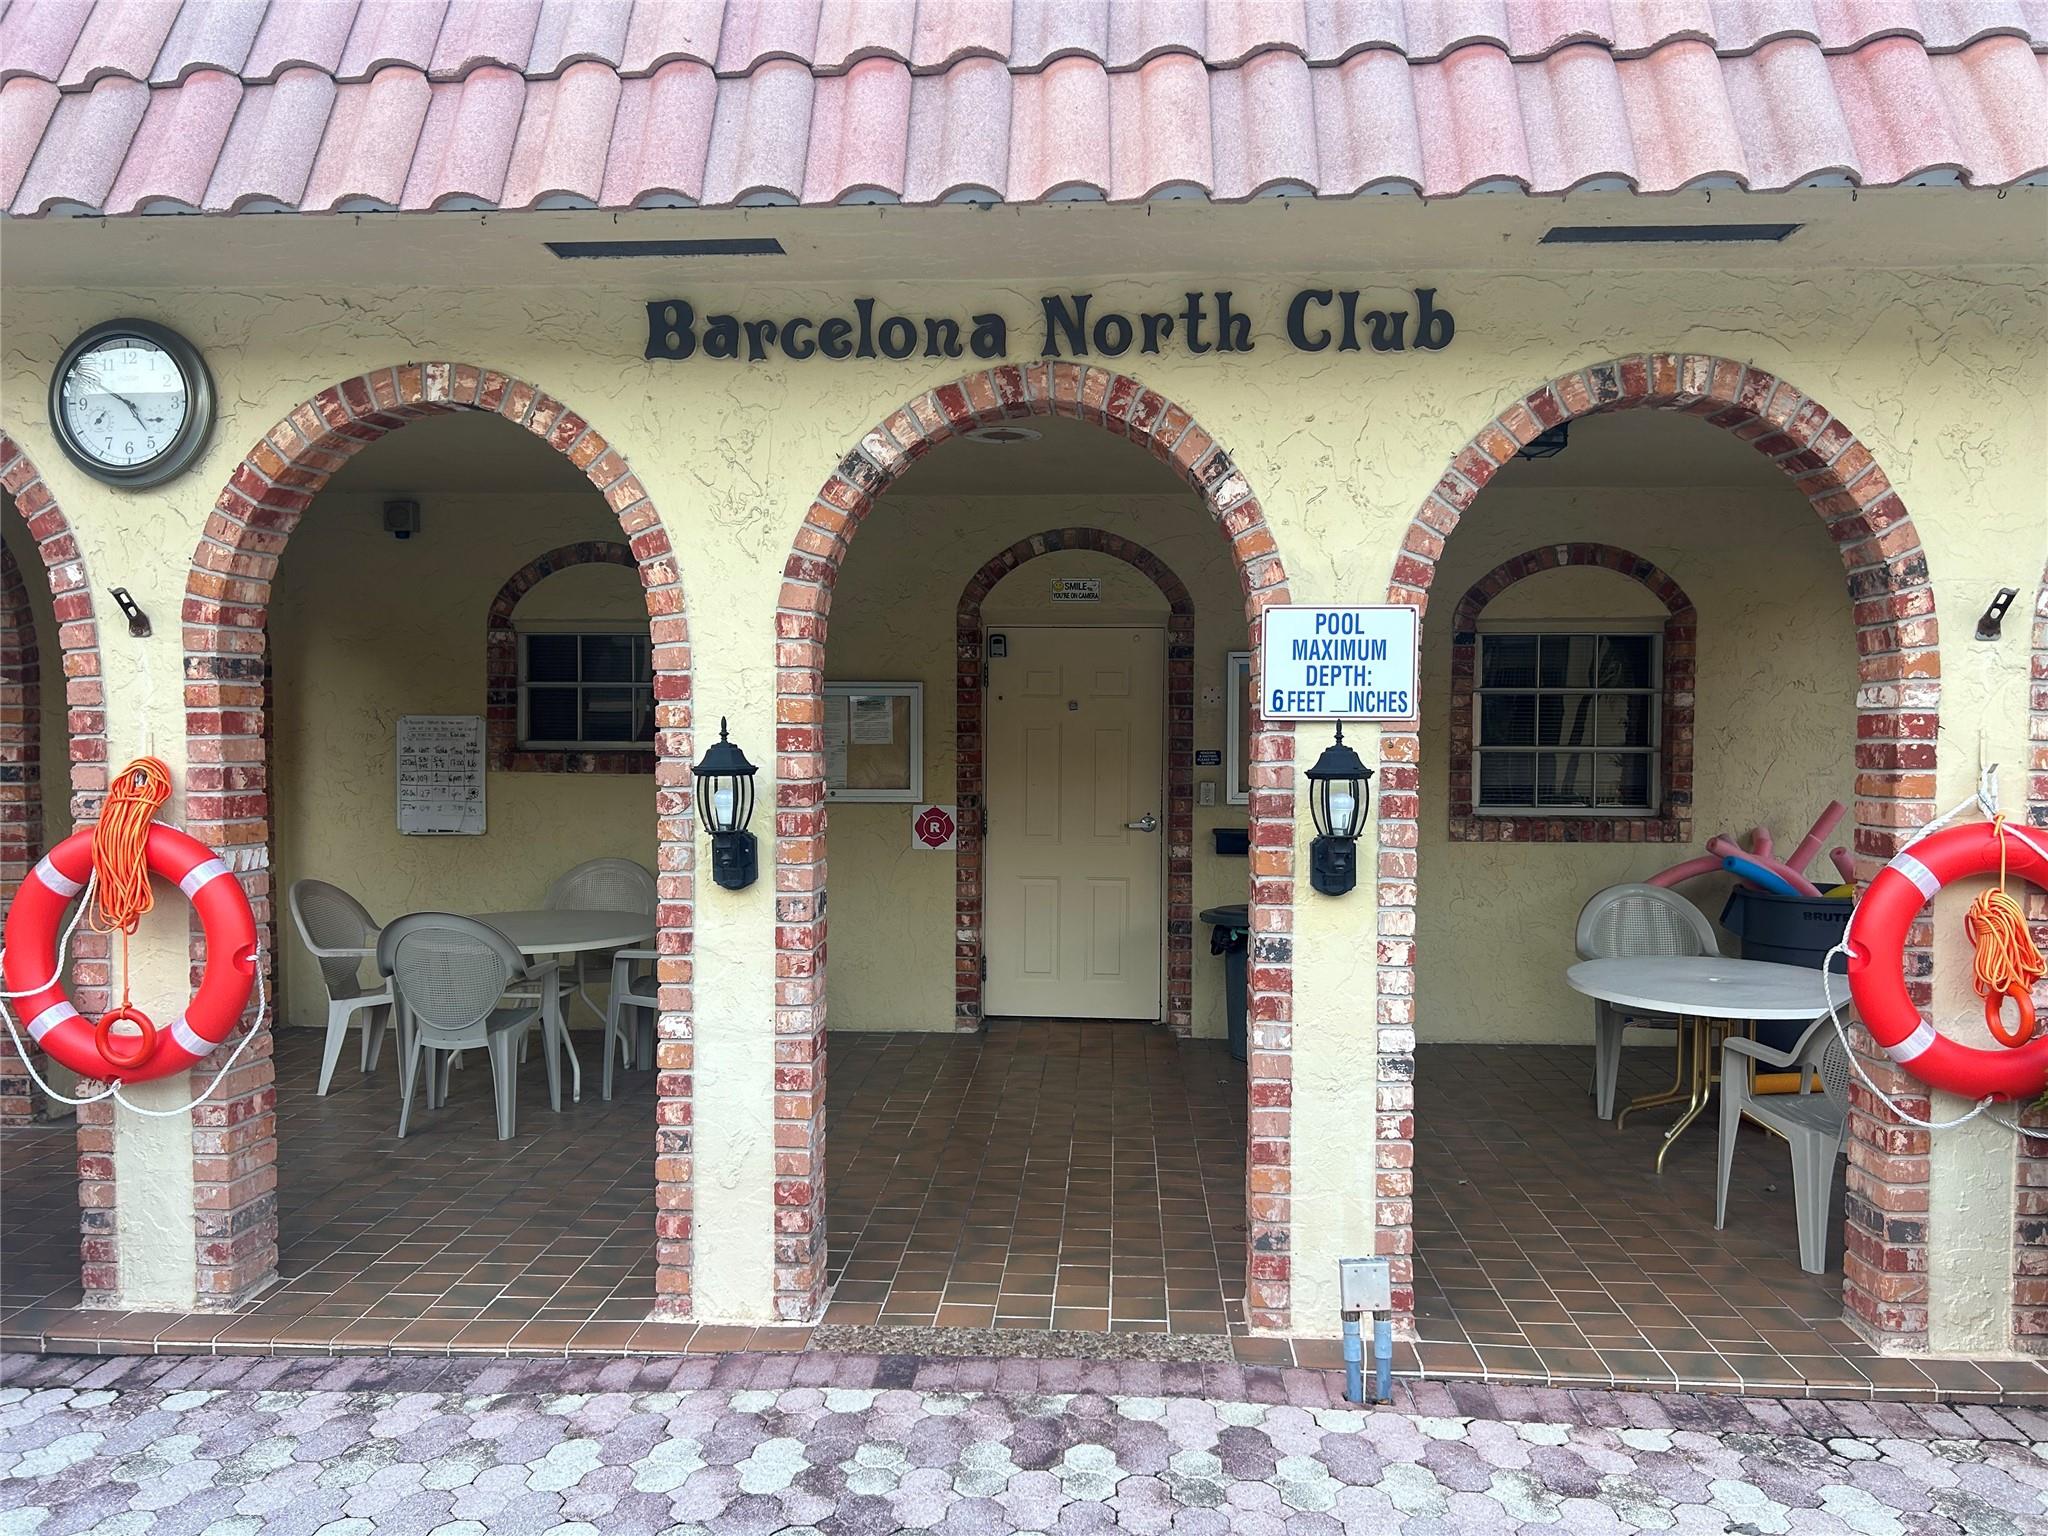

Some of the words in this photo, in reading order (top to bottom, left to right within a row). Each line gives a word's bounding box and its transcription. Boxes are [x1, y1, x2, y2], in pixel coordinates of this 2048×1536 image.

[645, 298, 1008, 362] Barcelona
[1041, 290, 1255, 360] North
[1286, 287, 1456, 356] Club
[122, 351, 138, 364] 12
[102, 359, 115, 371] 11
[149, 359, 156, 370] 1
[162, 375, 172, 387] 2
[79, 398, 88, 411] 9
[171, 396, 180, 410] 3
[105, 437, 113, 449] 7
[125, 442, 134, 454] 6
[147, 436, 156, 449] 5
[1065, 582, 1087, 590] SMILE
[1316, 613, 1365, 635] POOL
[1292, 639, 1387, 661] MAXIMUM
[1306, 665, 1372, 687] DEPTH:
[1272, 689, 1284, 712] 6
[1287, 691, 1325, 712] FEET
[1348, 690, 1408, 713] INCHES
[930, 822, 940, 833] R
